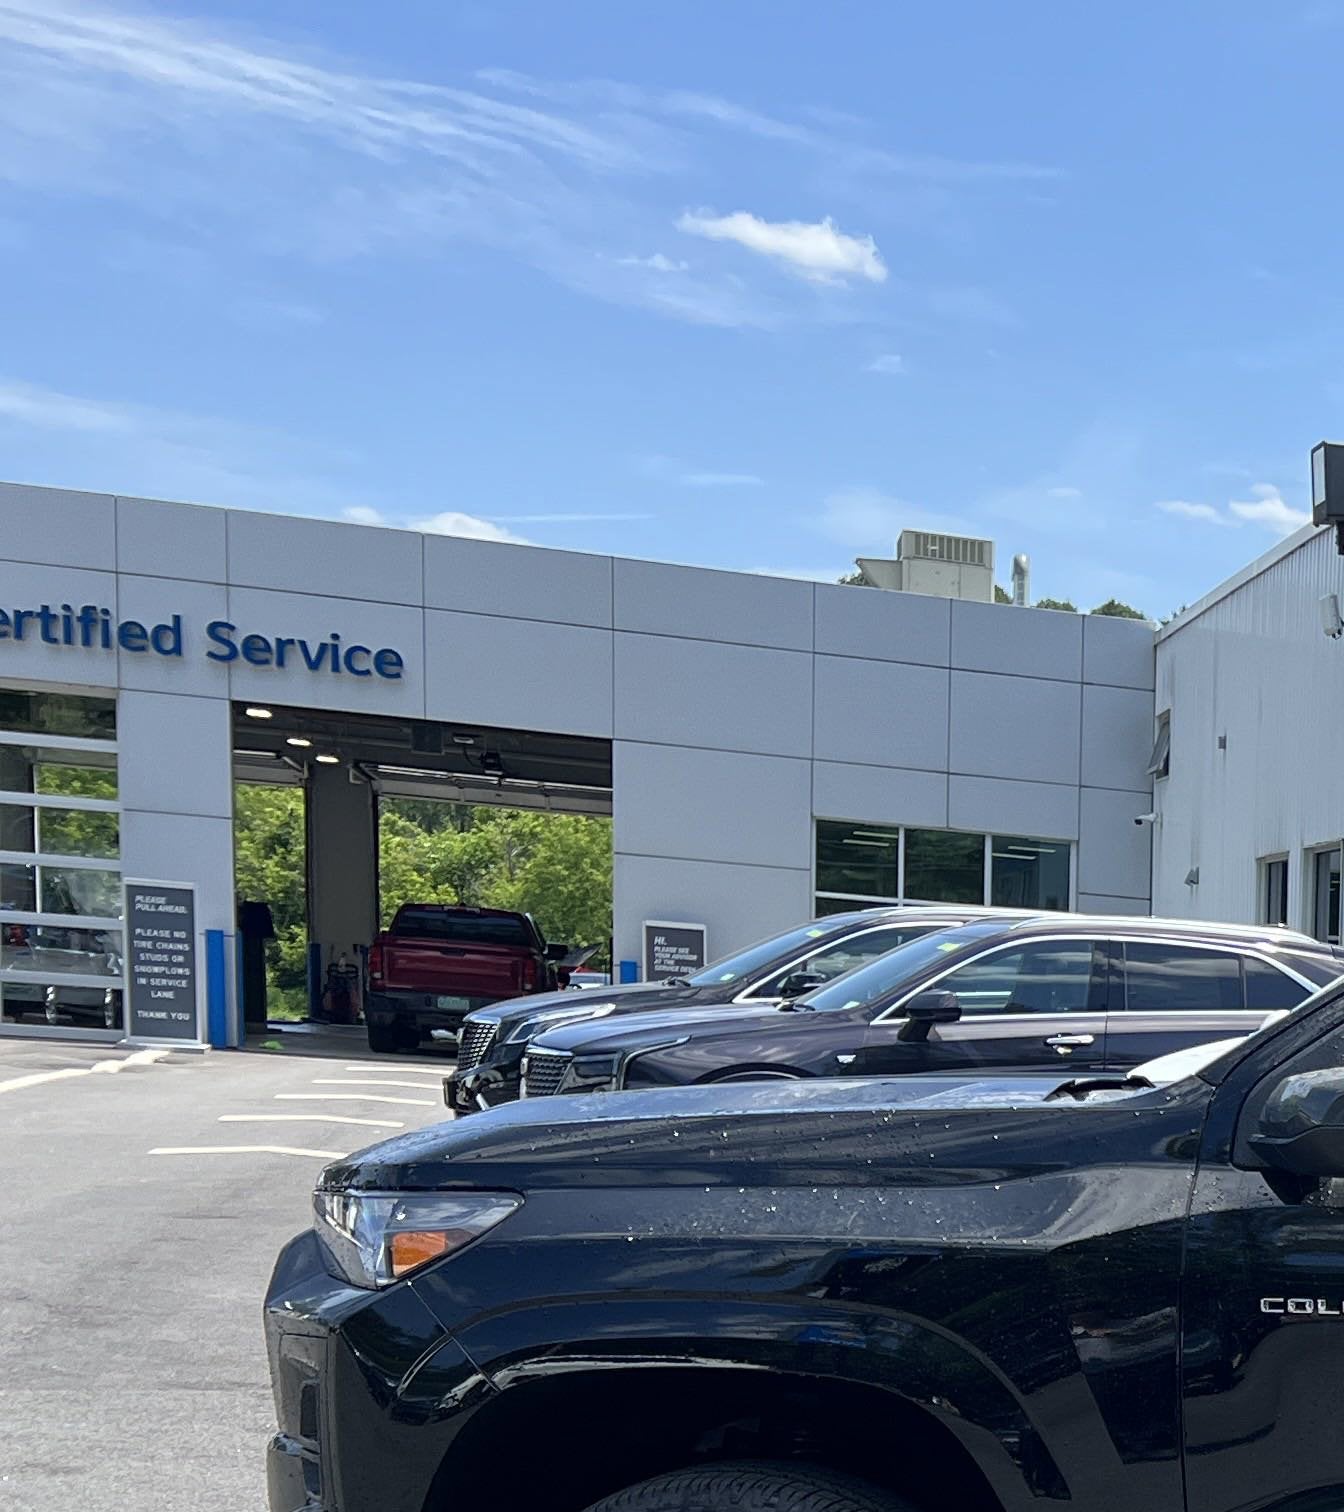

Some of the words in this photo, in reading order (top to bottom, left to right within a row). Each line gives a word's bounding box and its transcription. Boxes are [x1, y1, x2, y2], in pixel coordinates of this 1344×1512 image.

[206, 619, 404, 680] Service
[135, 928, 171, 938] PLEASE
[173, 930, 186, 939] NO
[133, 940, 153, 949] TIRE
[155, 942, 190, 951] CHAINS
[134, 964, 191, 976] SNOWPLOWS
[136, 977, 147, 985] IN
[149, 977, 188, 988] SERVICE
[150, 990, 175, 999] LANE
[137, 1010, 168, 1019] THANK
[170, 1012, 190, 1021] YOU
